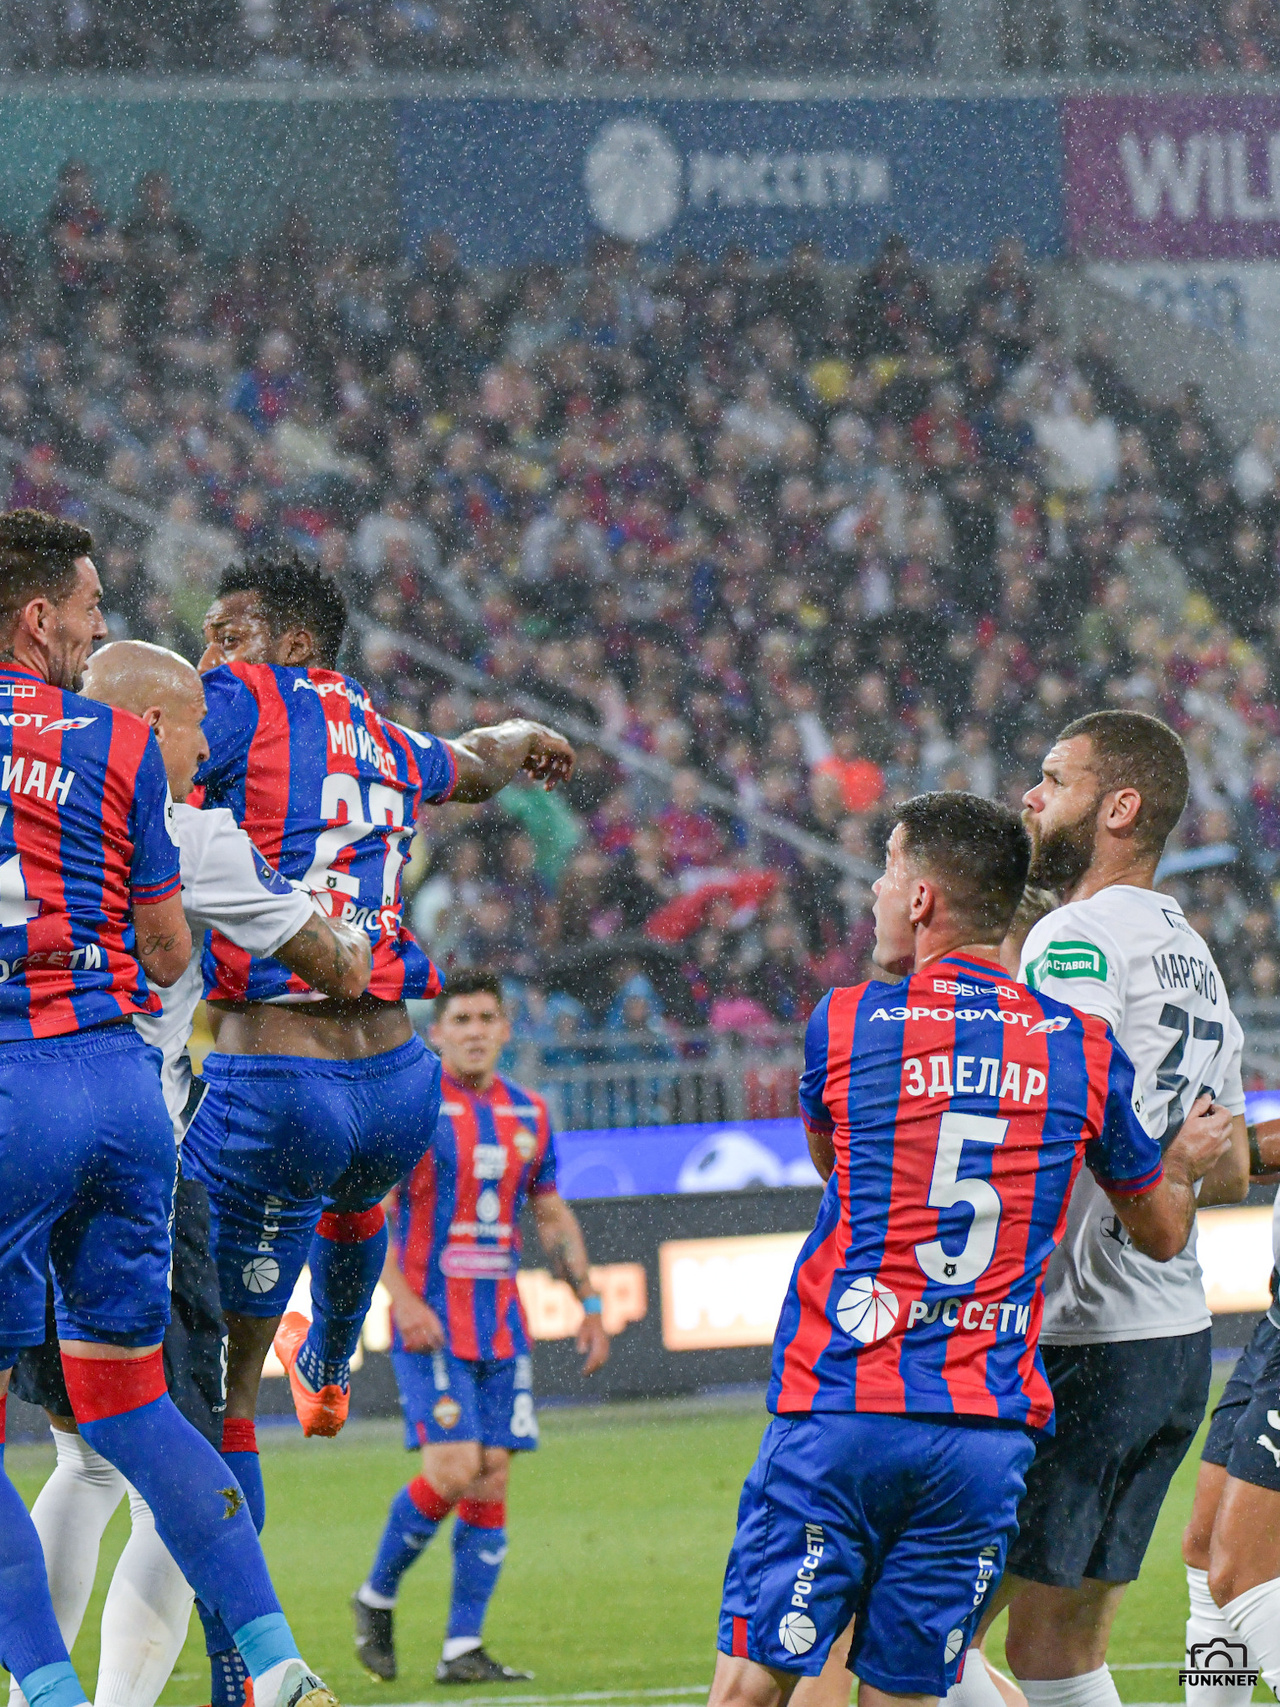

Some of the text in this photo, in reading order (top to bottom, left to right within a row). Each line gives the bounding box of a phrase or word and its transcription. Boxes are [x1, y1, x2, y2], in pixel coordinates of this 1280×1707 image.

[300, 772, 414, 906] 27
[868, 1006, 1033, 1028] АЭРОФЛОТ
[903, 1055, 1047, 1105] ЗДЕЛАР
[914, 1112, 1010, 1287] 5
[906, 1297, 1030, 1335] РОССЕТИ
[790, 1521, 825, 1610] РОССЕТИ
